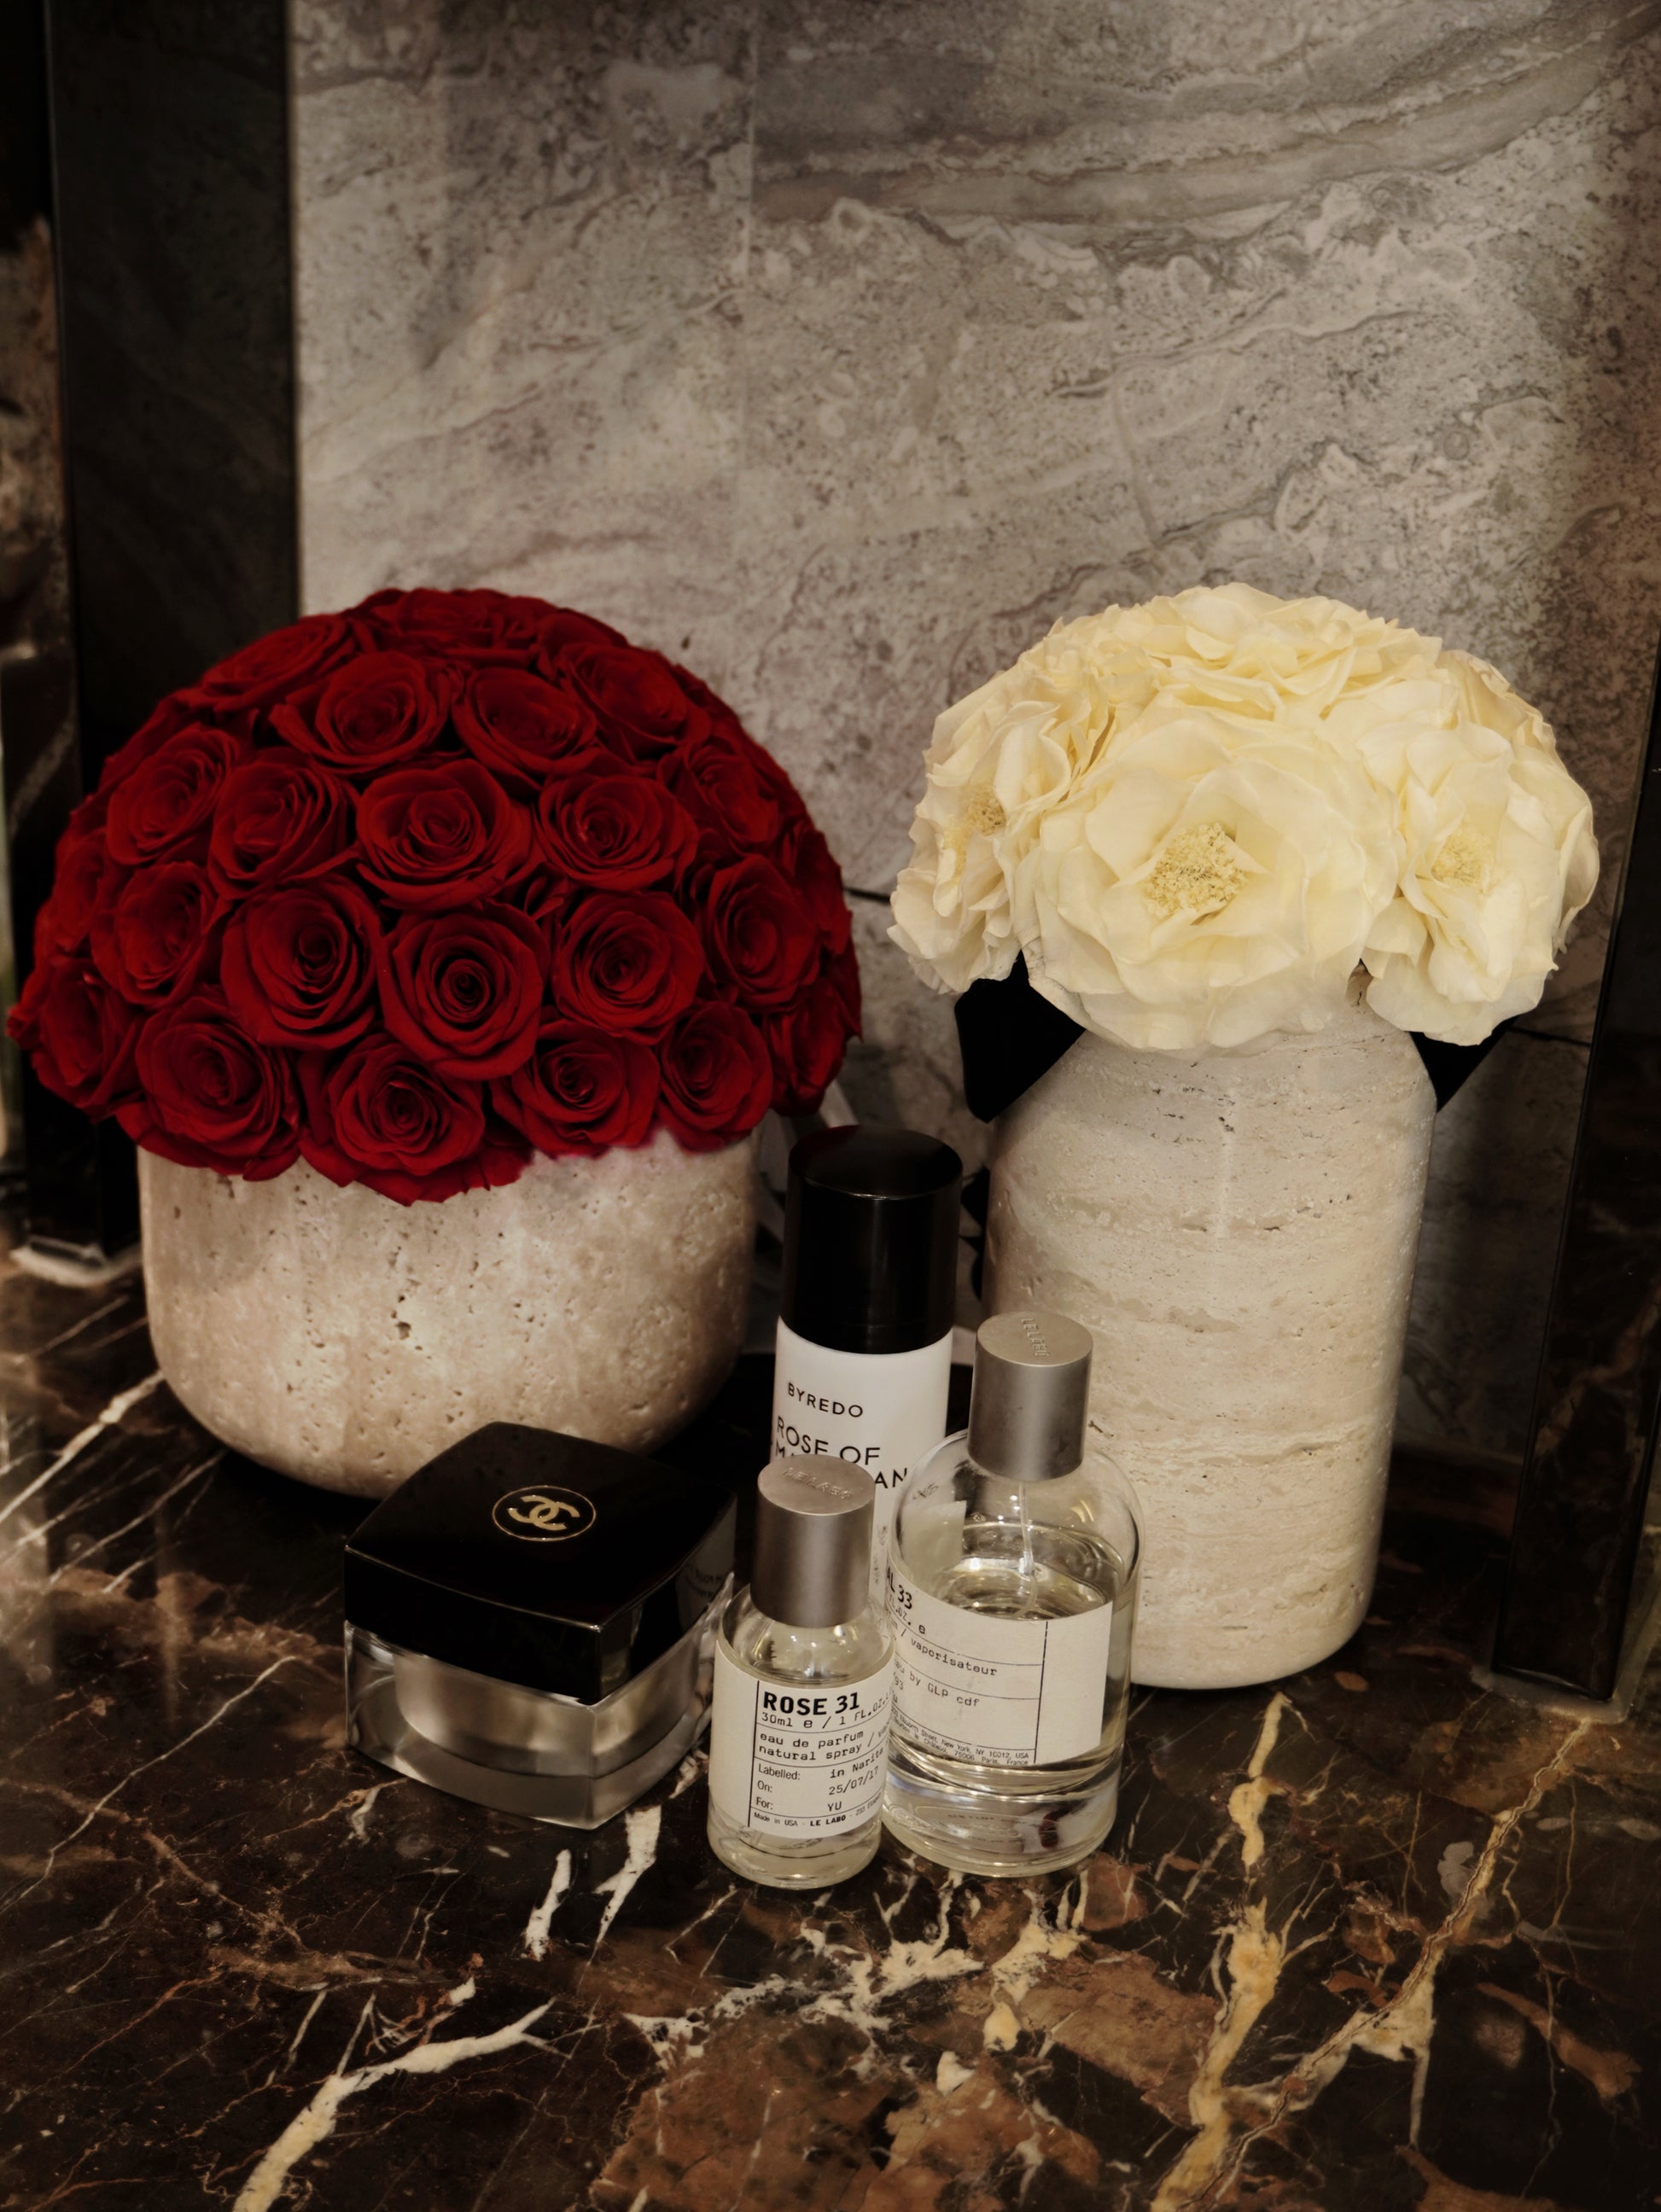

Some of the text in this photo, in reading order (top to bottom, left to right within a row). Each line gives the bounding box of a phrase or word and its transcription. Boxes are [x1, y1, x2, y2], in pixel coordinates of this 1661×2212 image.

[788, 1382, 863, 1417] BYREDO
[840, 1446, 881, 1465] OF
[897, 1584, 912, 1610] 33
[910, 1638, 998, 1676] vaporisateur
[762, 1691, 860, 1716] ROSE 31
[956, 1694, 981, 1708] cdf
[761, 1712, 794, 1727] 30ml
[760, 1730, 864, 1749] eau de parfum
[759, 1745, 817, 1761] natural
[825, 1743, 863, 1761] spray
[757, 1766, 879, 1796] On: 25/07/17
[758, 1763, 801, 1780] Labelled:
[830, 1768, 845, 1779] in
[755, 1796, 842, 1813] For: YU
[754, 1812, 771, 1823] Made
[825, 1815, 847, 1825] LABO
